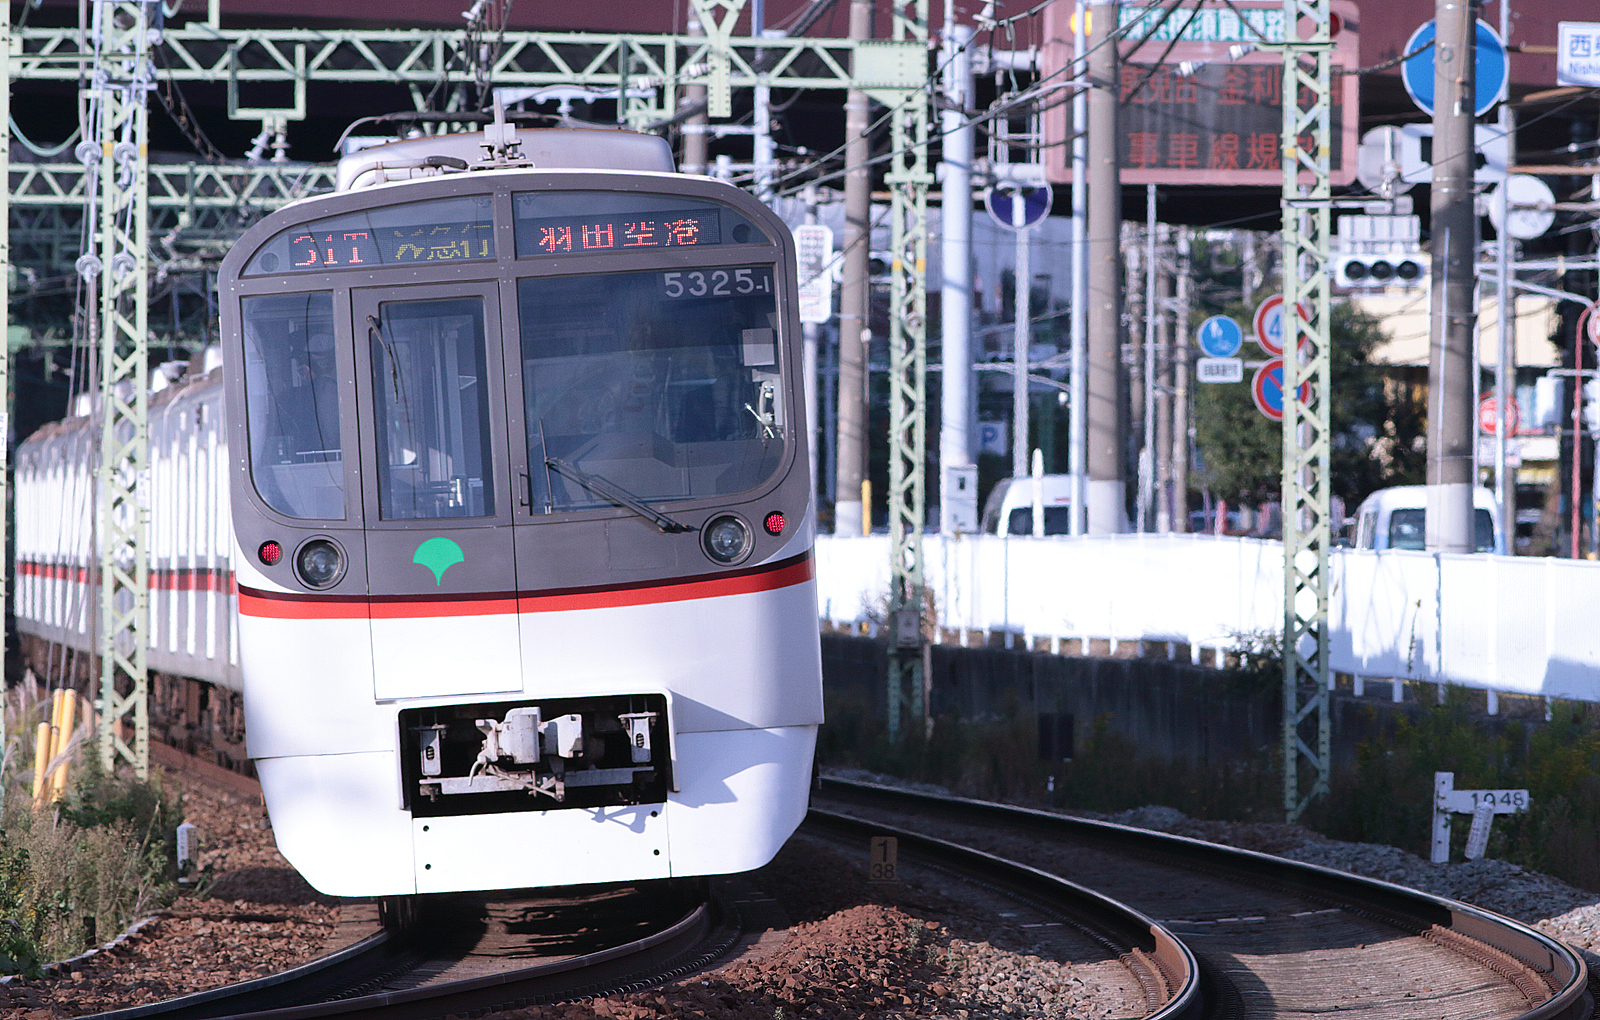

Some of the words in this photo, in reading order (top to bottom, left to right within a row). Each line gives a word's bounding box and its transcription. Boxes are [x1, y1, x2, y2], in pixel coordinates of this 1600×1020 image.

[538, 218, 699, 253] 羽田空港
[877, 840, 888, 862] 1
[872, 863, 895, 879] 38
